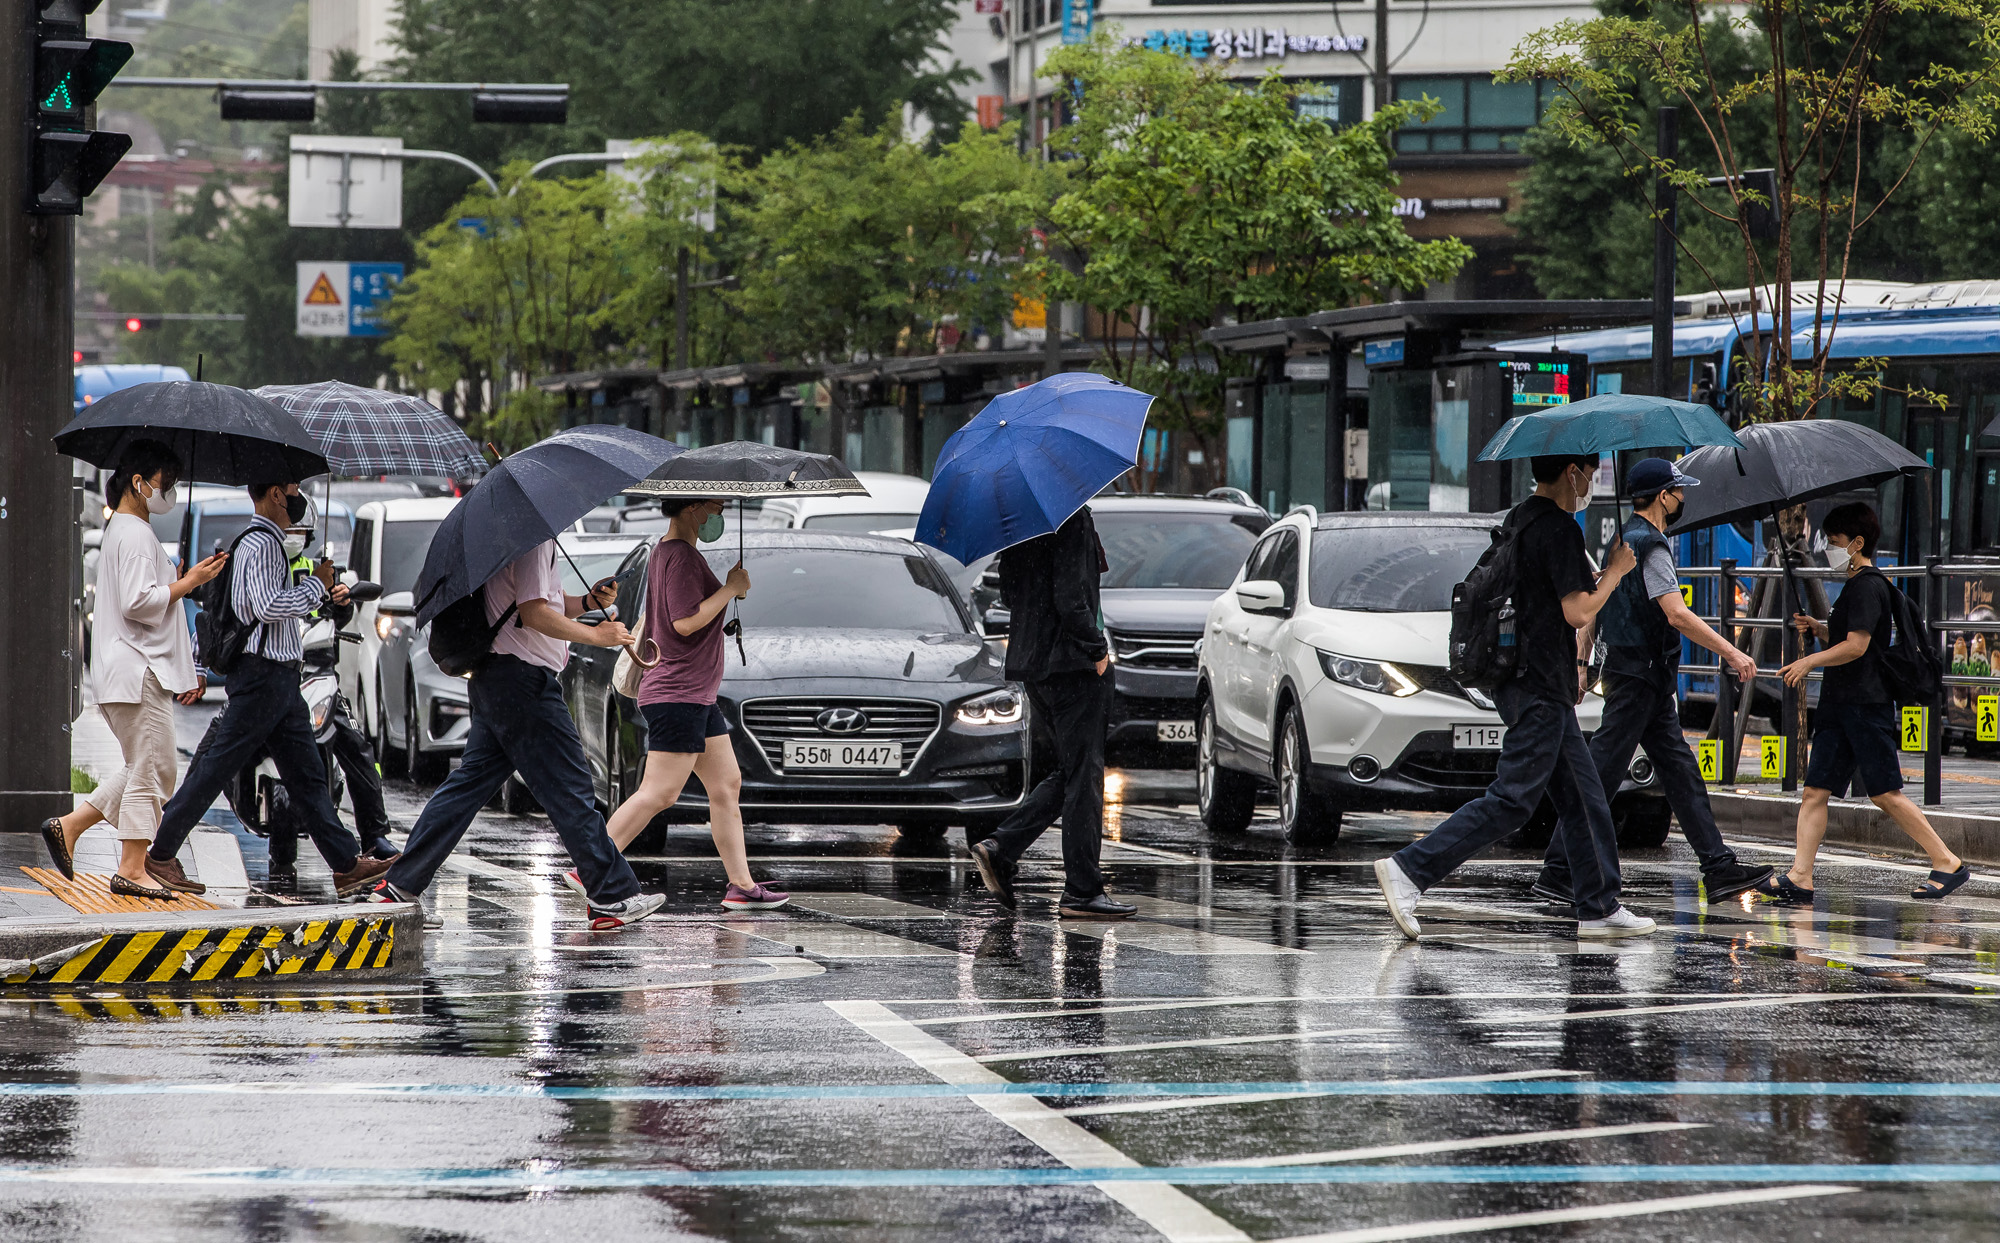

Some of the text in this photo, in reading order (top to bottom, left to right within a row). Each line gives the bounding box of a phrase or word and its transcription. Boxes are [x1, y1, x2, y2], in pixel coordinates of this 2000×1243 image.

[1465, 729, 1499, 746] 11모
[795, 746, 891, 765] 55하 0447
